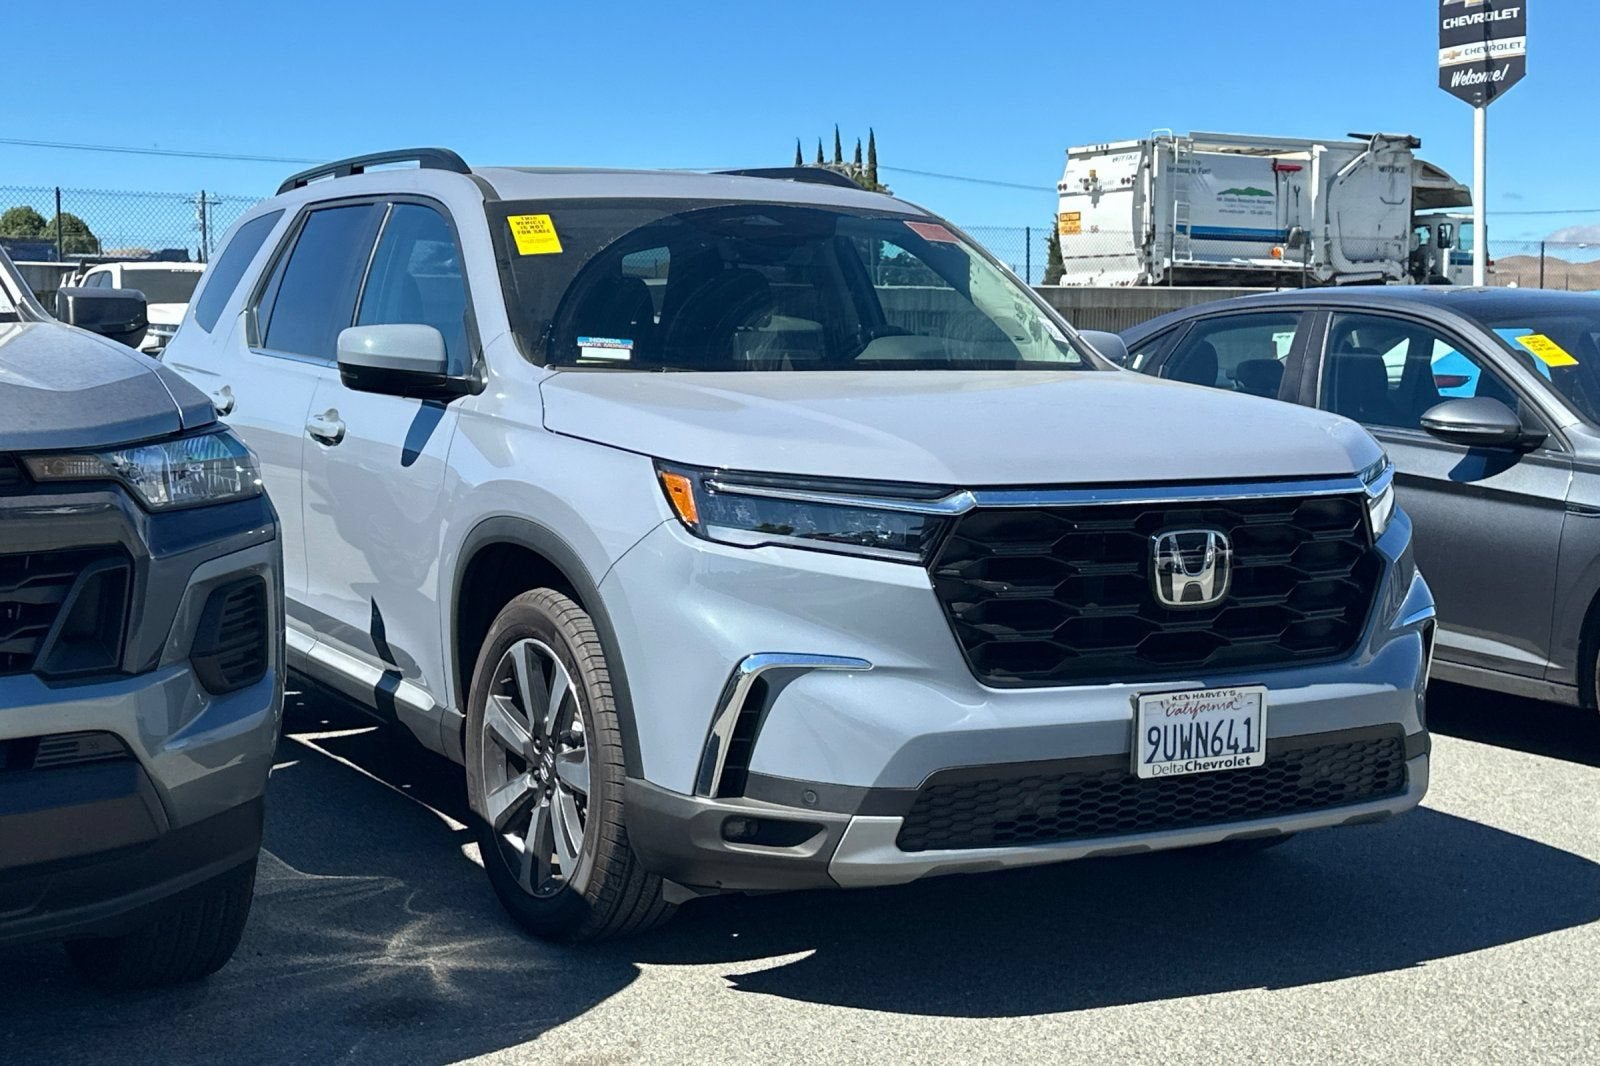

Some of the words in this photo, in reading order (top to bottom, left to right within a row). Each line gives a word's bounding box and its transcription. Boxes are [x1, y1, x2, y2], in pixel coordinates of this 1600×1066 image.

[1443, 7, 1521, 29] CHEVROLET
[1464, 41, 1522, 56] CHEVROLET
[1451, 63, 1510, 88] Welcome!
[1192, 690, 1237, 699] HARVEY'S
[1165, 699, 1241, 720] California
[1146, 717, 1256, 764] 9UWN641
